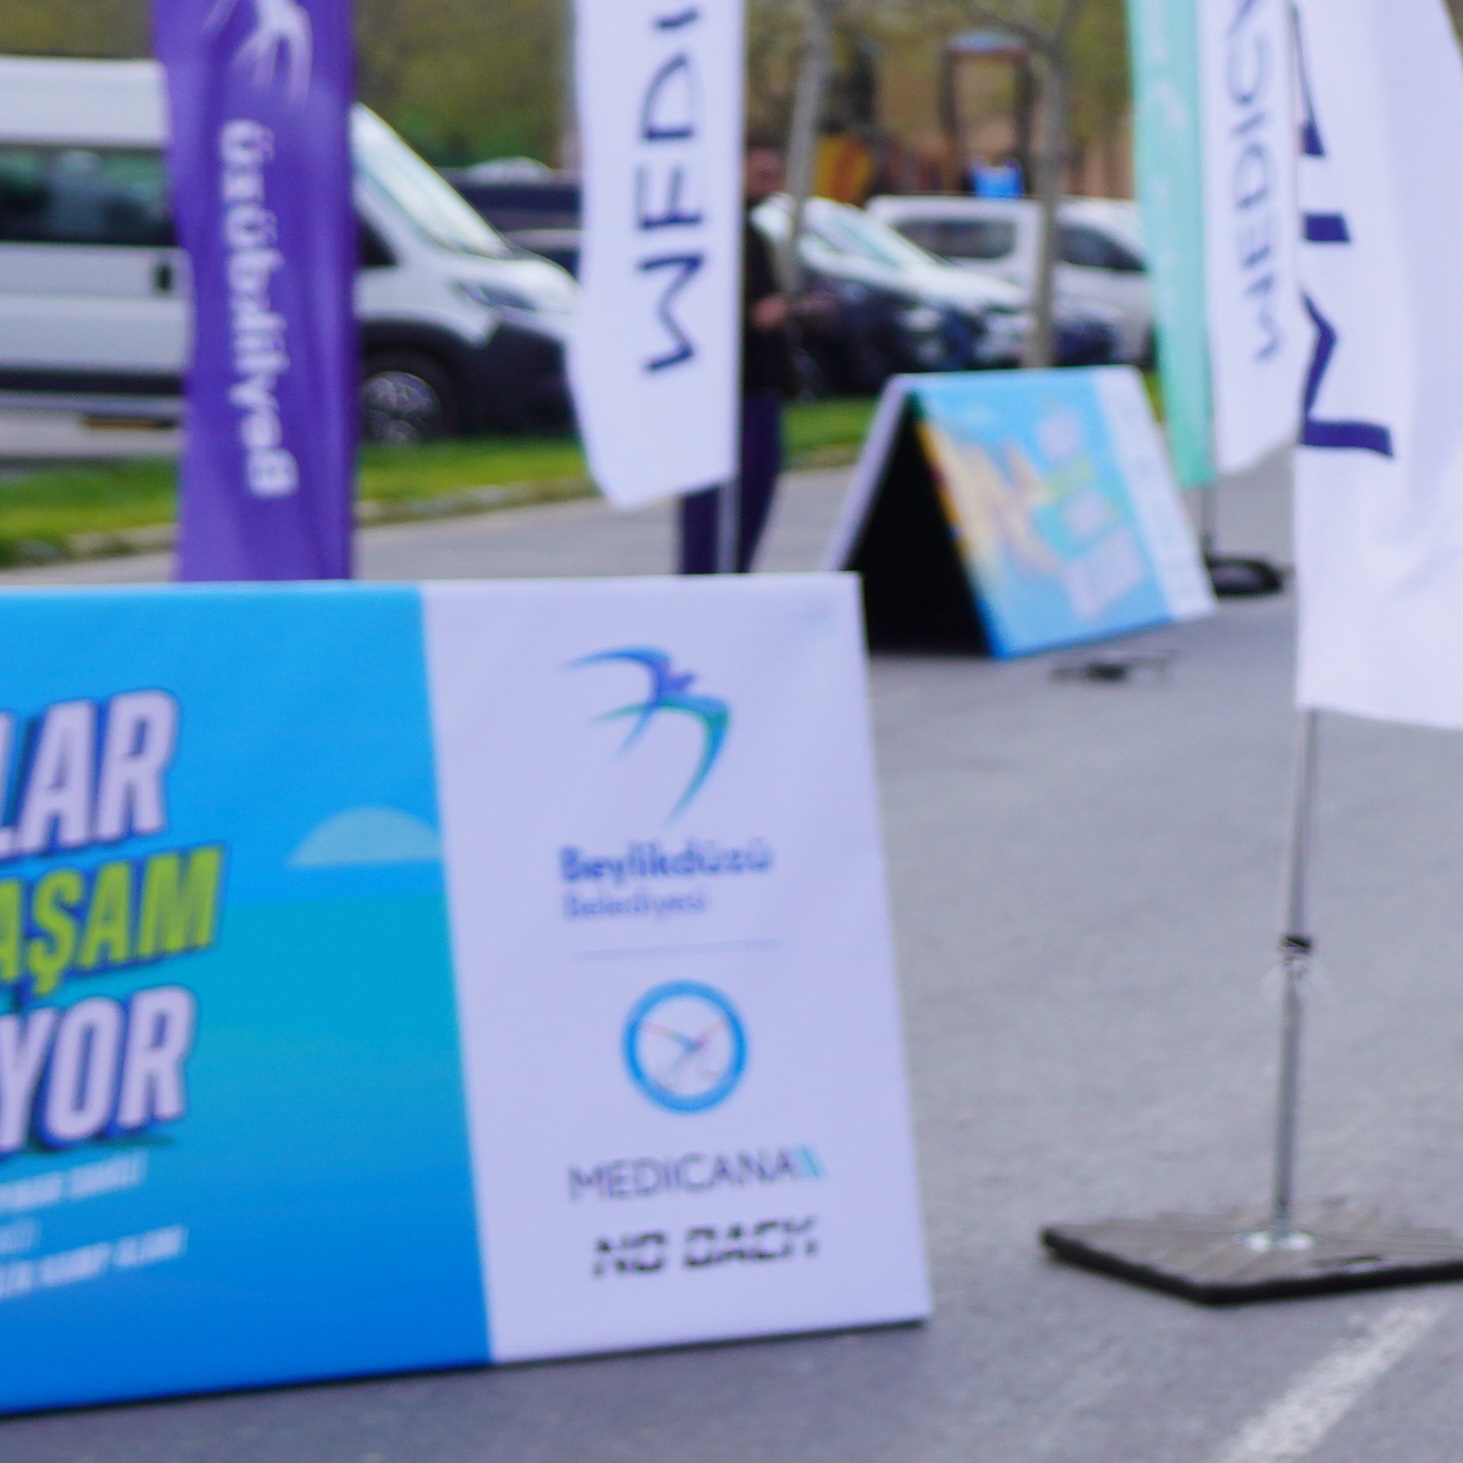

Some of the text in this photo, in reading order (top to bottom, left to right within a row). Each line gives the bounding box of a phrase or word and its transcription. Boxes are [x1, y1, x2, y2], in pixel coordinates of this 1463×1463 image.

[559, 839, 773, 884] Beylikdüzü
[561, 891, 708, 920] Belediyesi
[568, 1147, 799, 1202] MEDICANA
